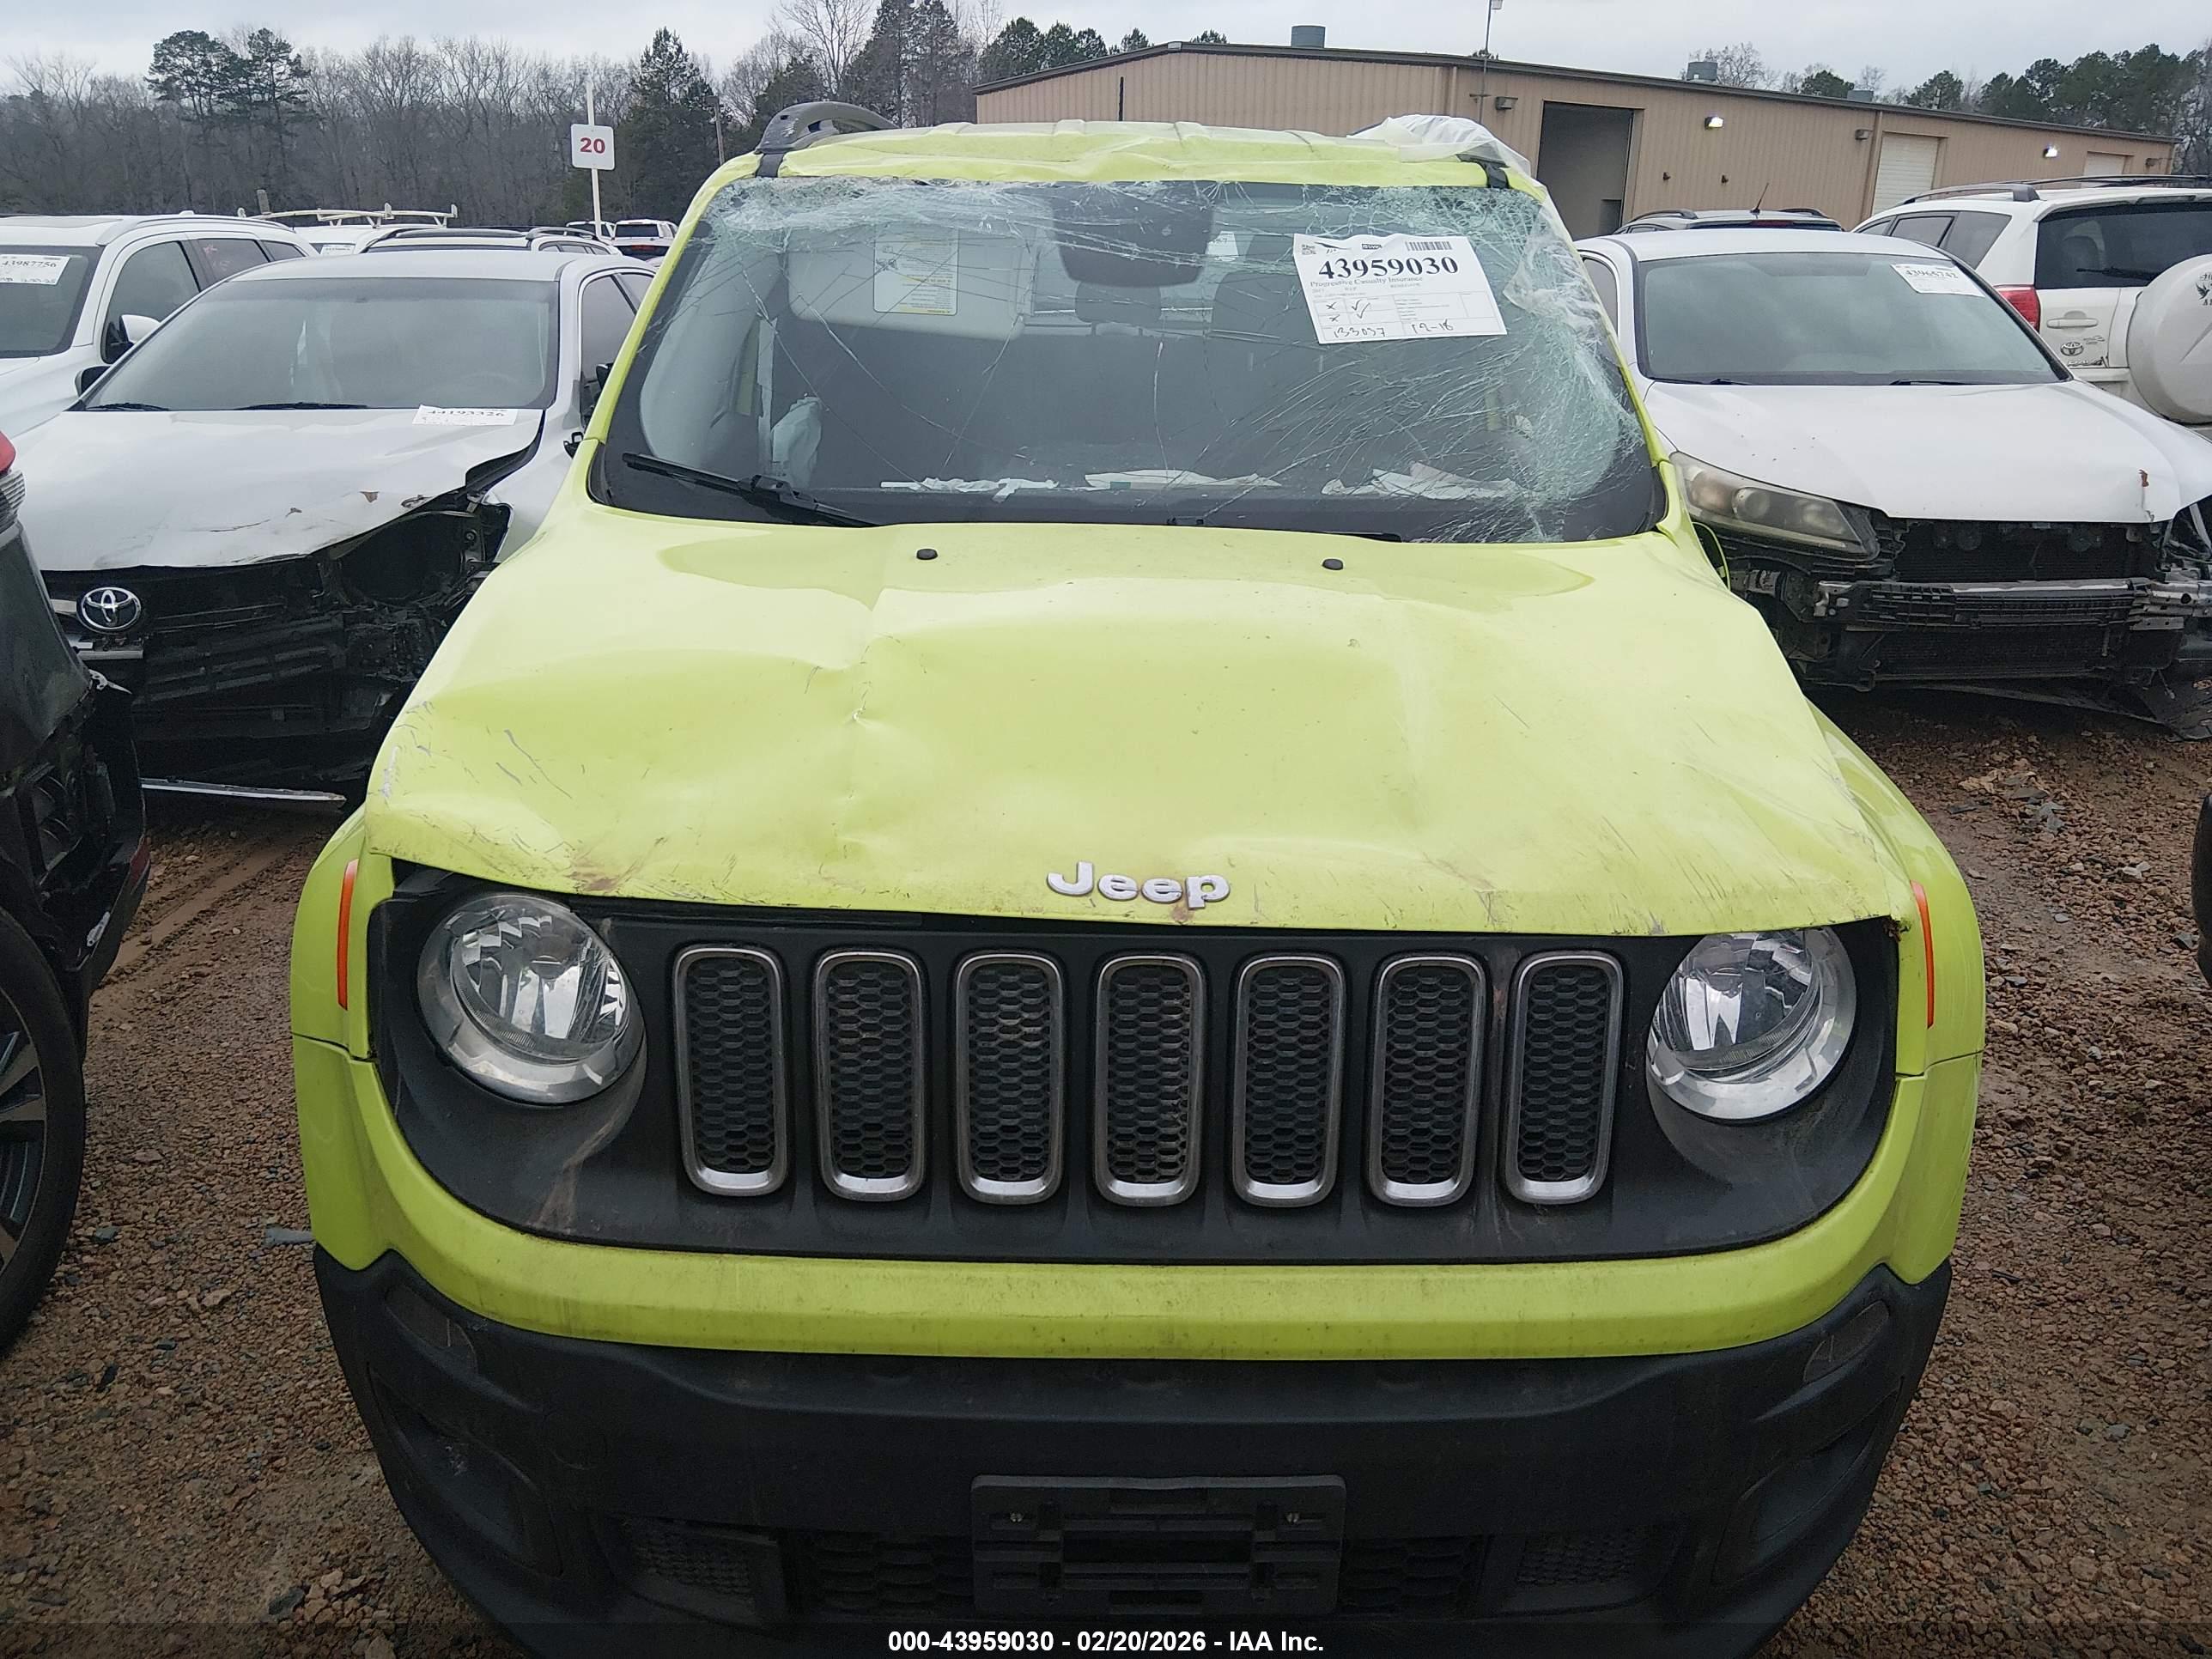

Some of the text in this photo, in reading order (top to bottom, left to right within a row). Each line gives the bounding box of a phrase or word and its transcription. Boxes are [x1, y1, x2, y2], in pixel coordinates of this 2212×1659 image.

[580, 137, 605, 154] 20
[1318, 257, 1458, 279] 43959030
[1310, 279, 1352, 288] Progressive
[1353, 277, 1386, 286] Casualty
[1047, 861, 1231, 910] Jeep
